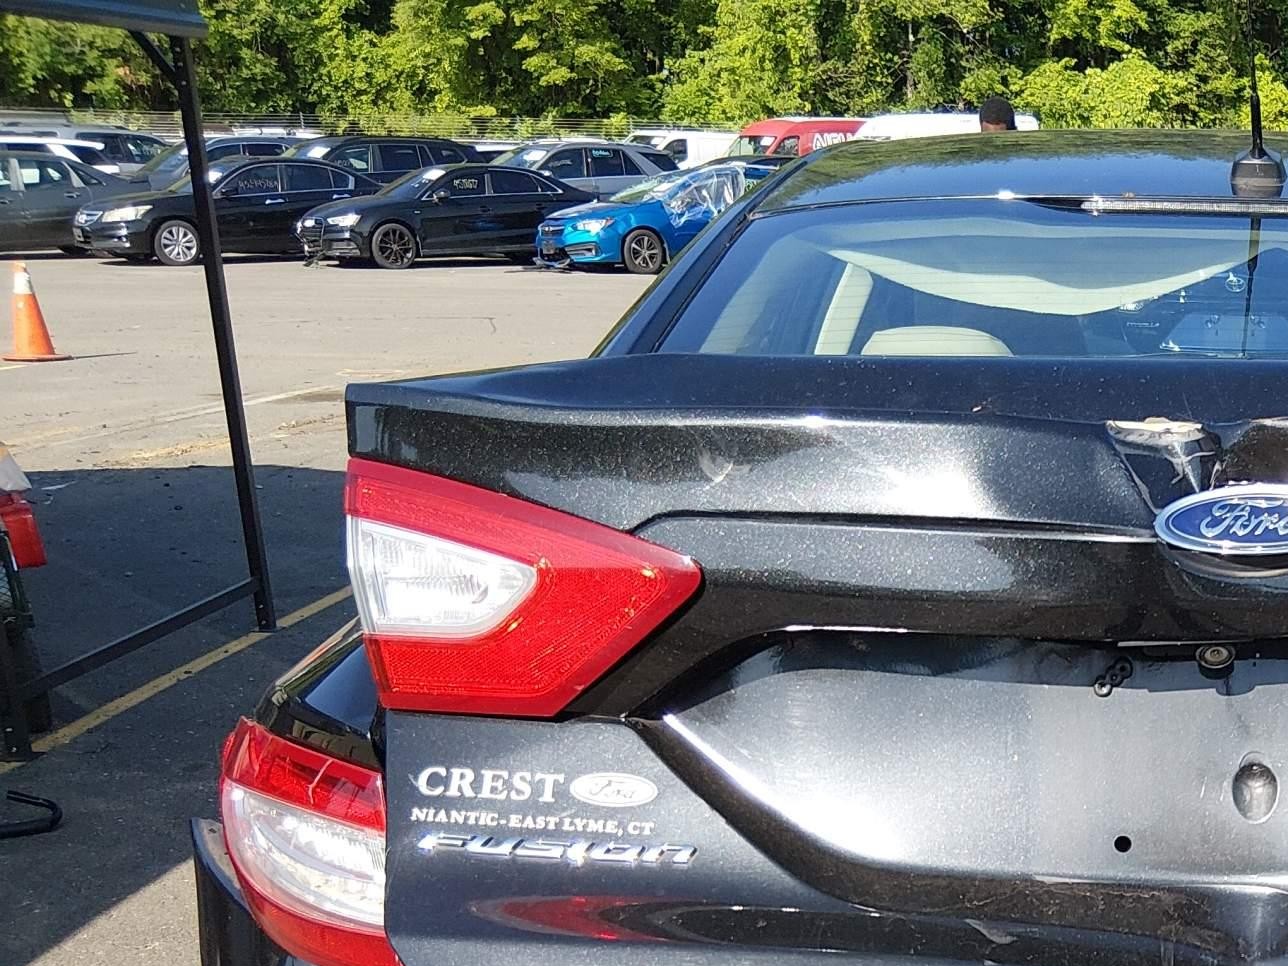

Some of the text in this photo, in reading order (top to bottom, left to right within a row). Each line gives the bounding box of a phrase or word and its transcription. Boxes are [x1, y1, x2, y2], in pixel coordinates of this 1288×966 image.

[417, 766, 564, 802] CREST
[411, 807, 655, 836] NIANTIC-EAST LYME, CT
